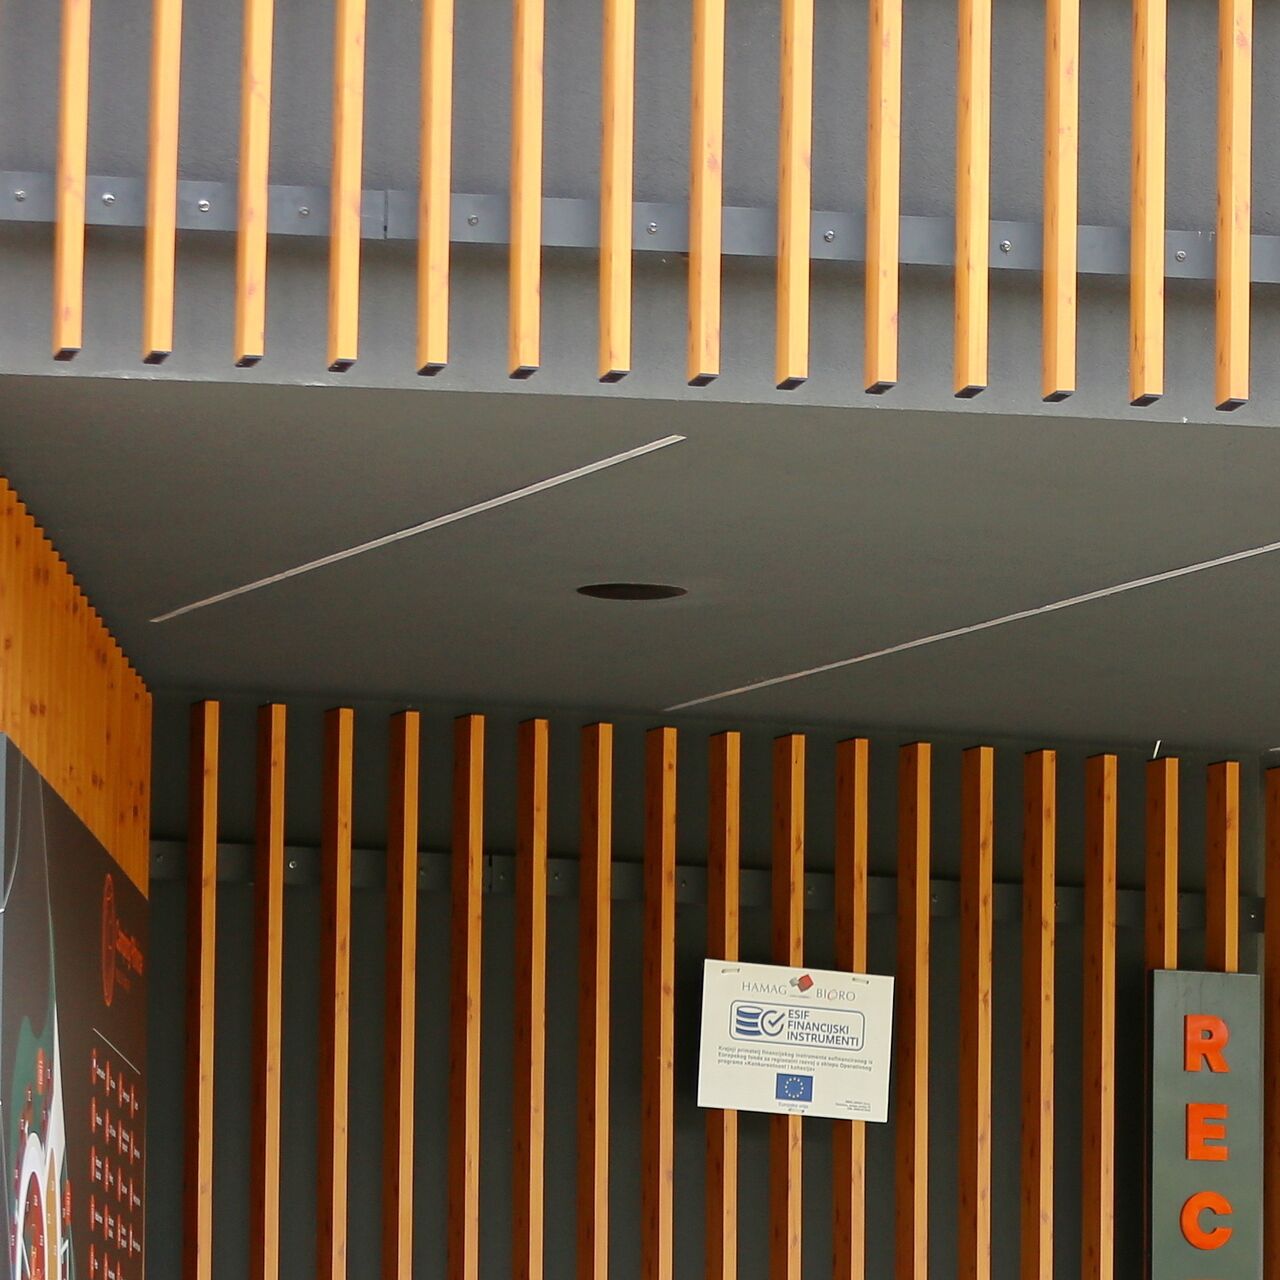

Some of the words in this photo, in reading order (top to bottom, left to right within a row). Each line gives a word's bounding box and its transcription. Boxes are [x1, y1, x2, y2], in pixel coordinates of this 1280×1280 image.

[742, 981, 787, 995] HAMAG
[788, 1009, 810, 1020] ESIF
[787, 1020, 849, 1035] FINANCIJSKI
[787, 1031, 859, 1047] INSTRUMENTI
